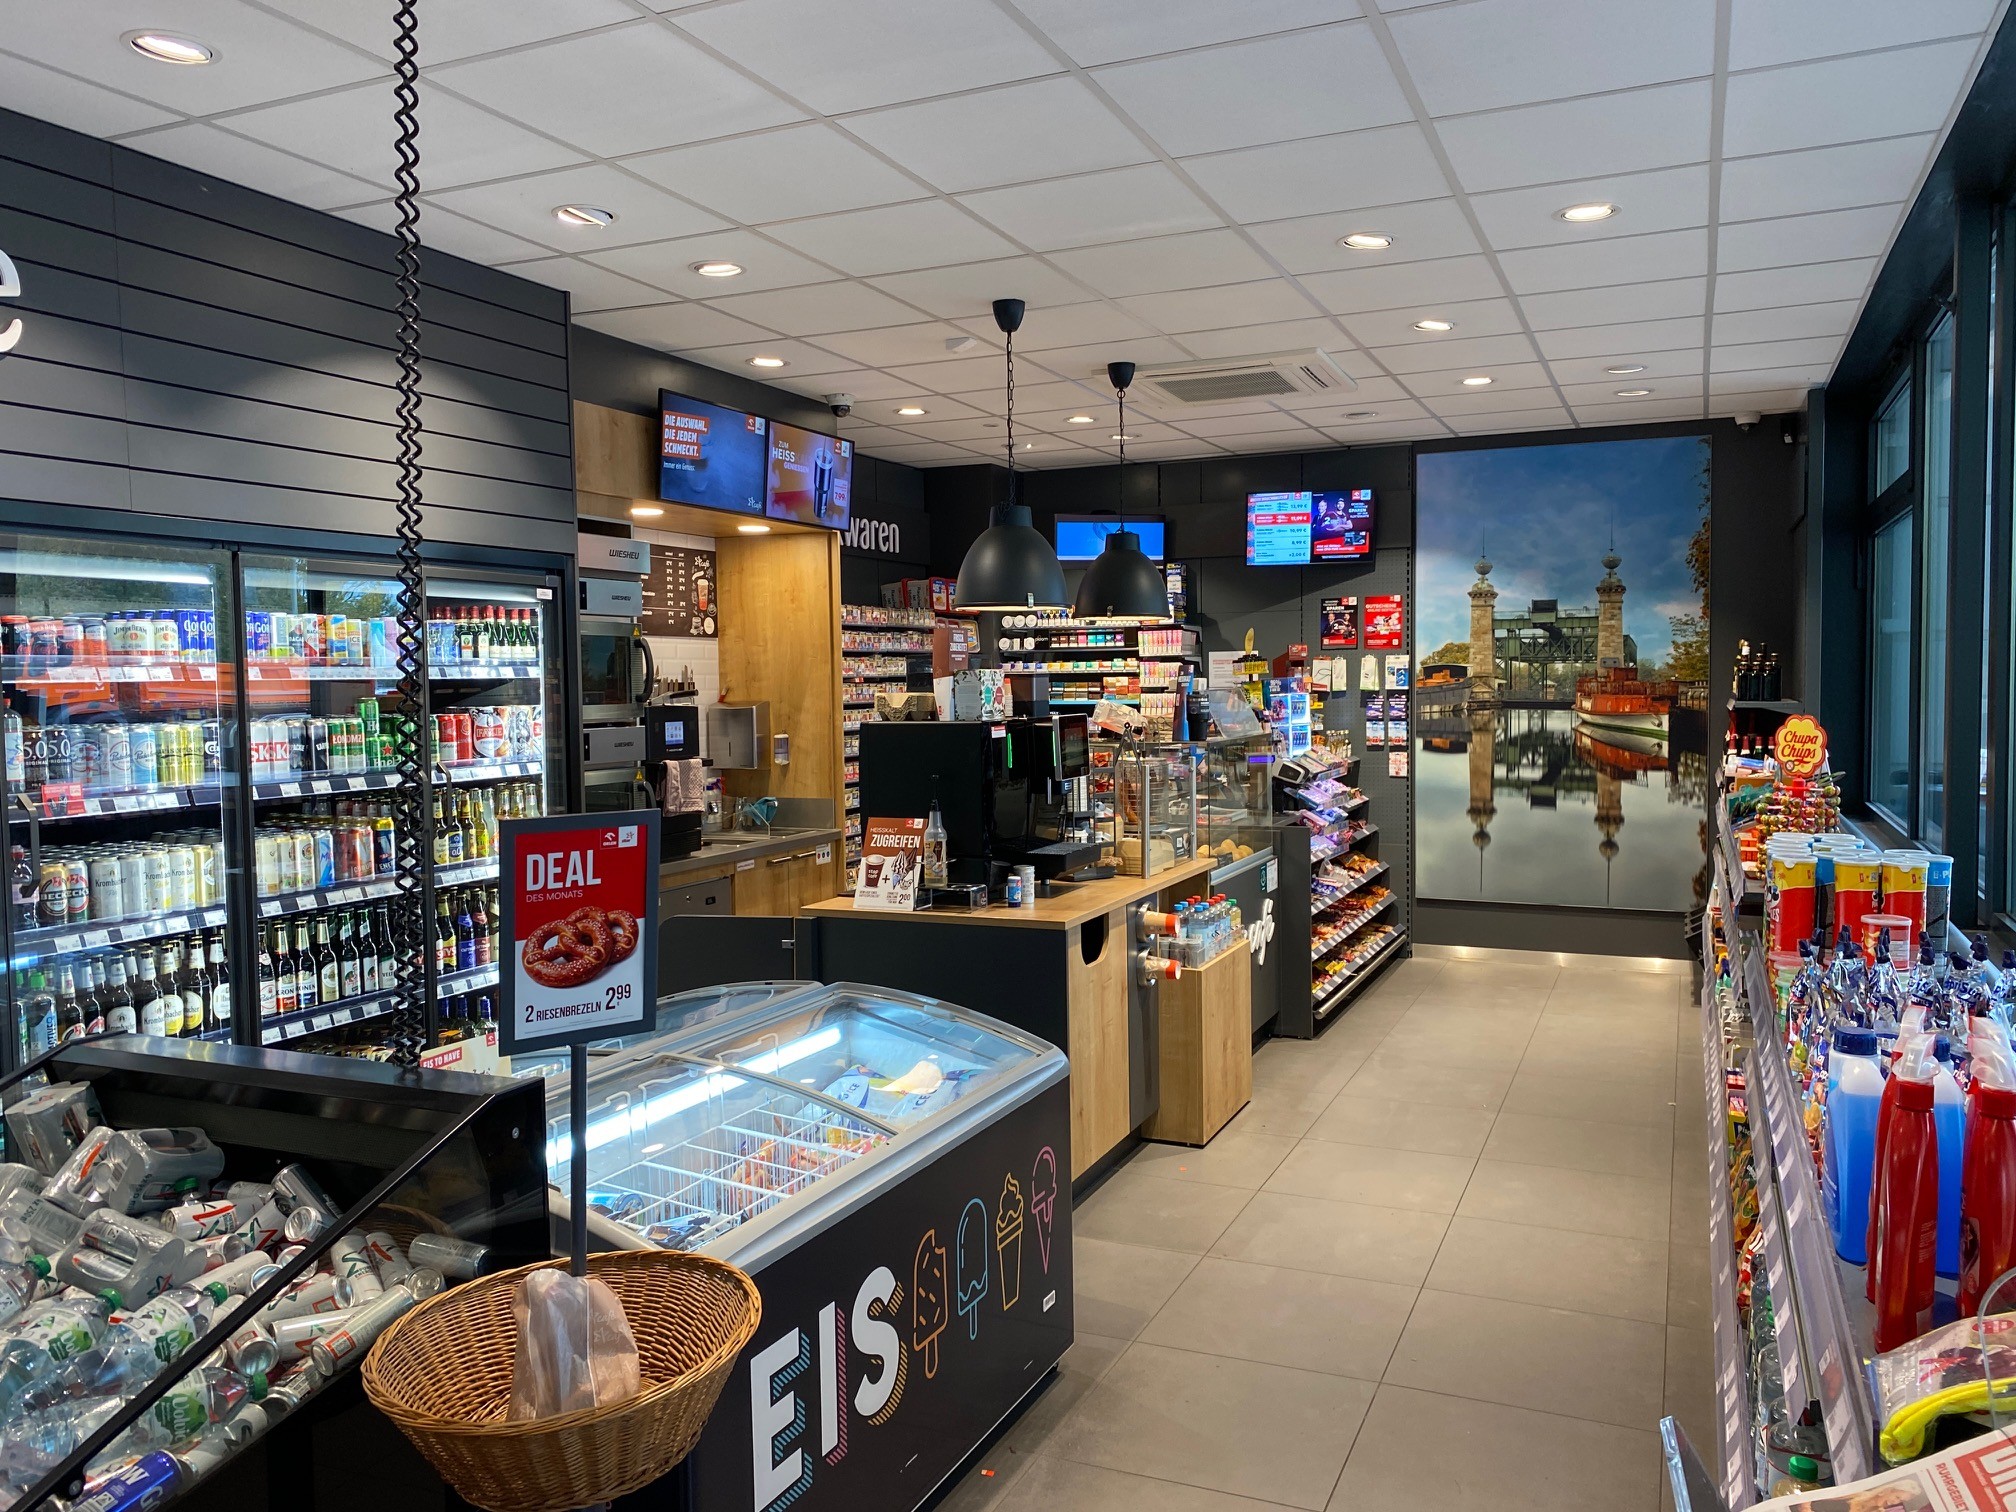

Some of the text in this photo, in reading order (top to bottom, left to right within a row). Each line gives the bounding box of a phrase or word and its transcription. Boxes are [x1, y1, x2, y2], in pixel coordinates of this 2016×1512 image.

[664, 414, 707, 433] DIE AUSWAHL,
[664, 428, 698, 443] DIE JEDEM
[664, 442, 699, 457] SCHMECKT.
[778, 440, 789, 449] ZUM
[772, 447, 796, 462] HEISS
[1784, 731, 1818, 747] Chupa
[1781, 744, 1816, 759] Chups
[870, 834, 921, 849] ZUGREIFEN
[526, 850, 601, 891] DEAL
[526, 890, 583, 903] DES MONATS
[525, 1005, 534, 1023] 2
[536, 1001, 602, 1022] RIESENBREZELN
[435, 1056, 443, 1067] TO
[443, 1049, 460, 1064] HAVE
[750, 1265, 908, 1512] EIS
[1934, 1462, 1971, 1512] RUHRGEBIET
